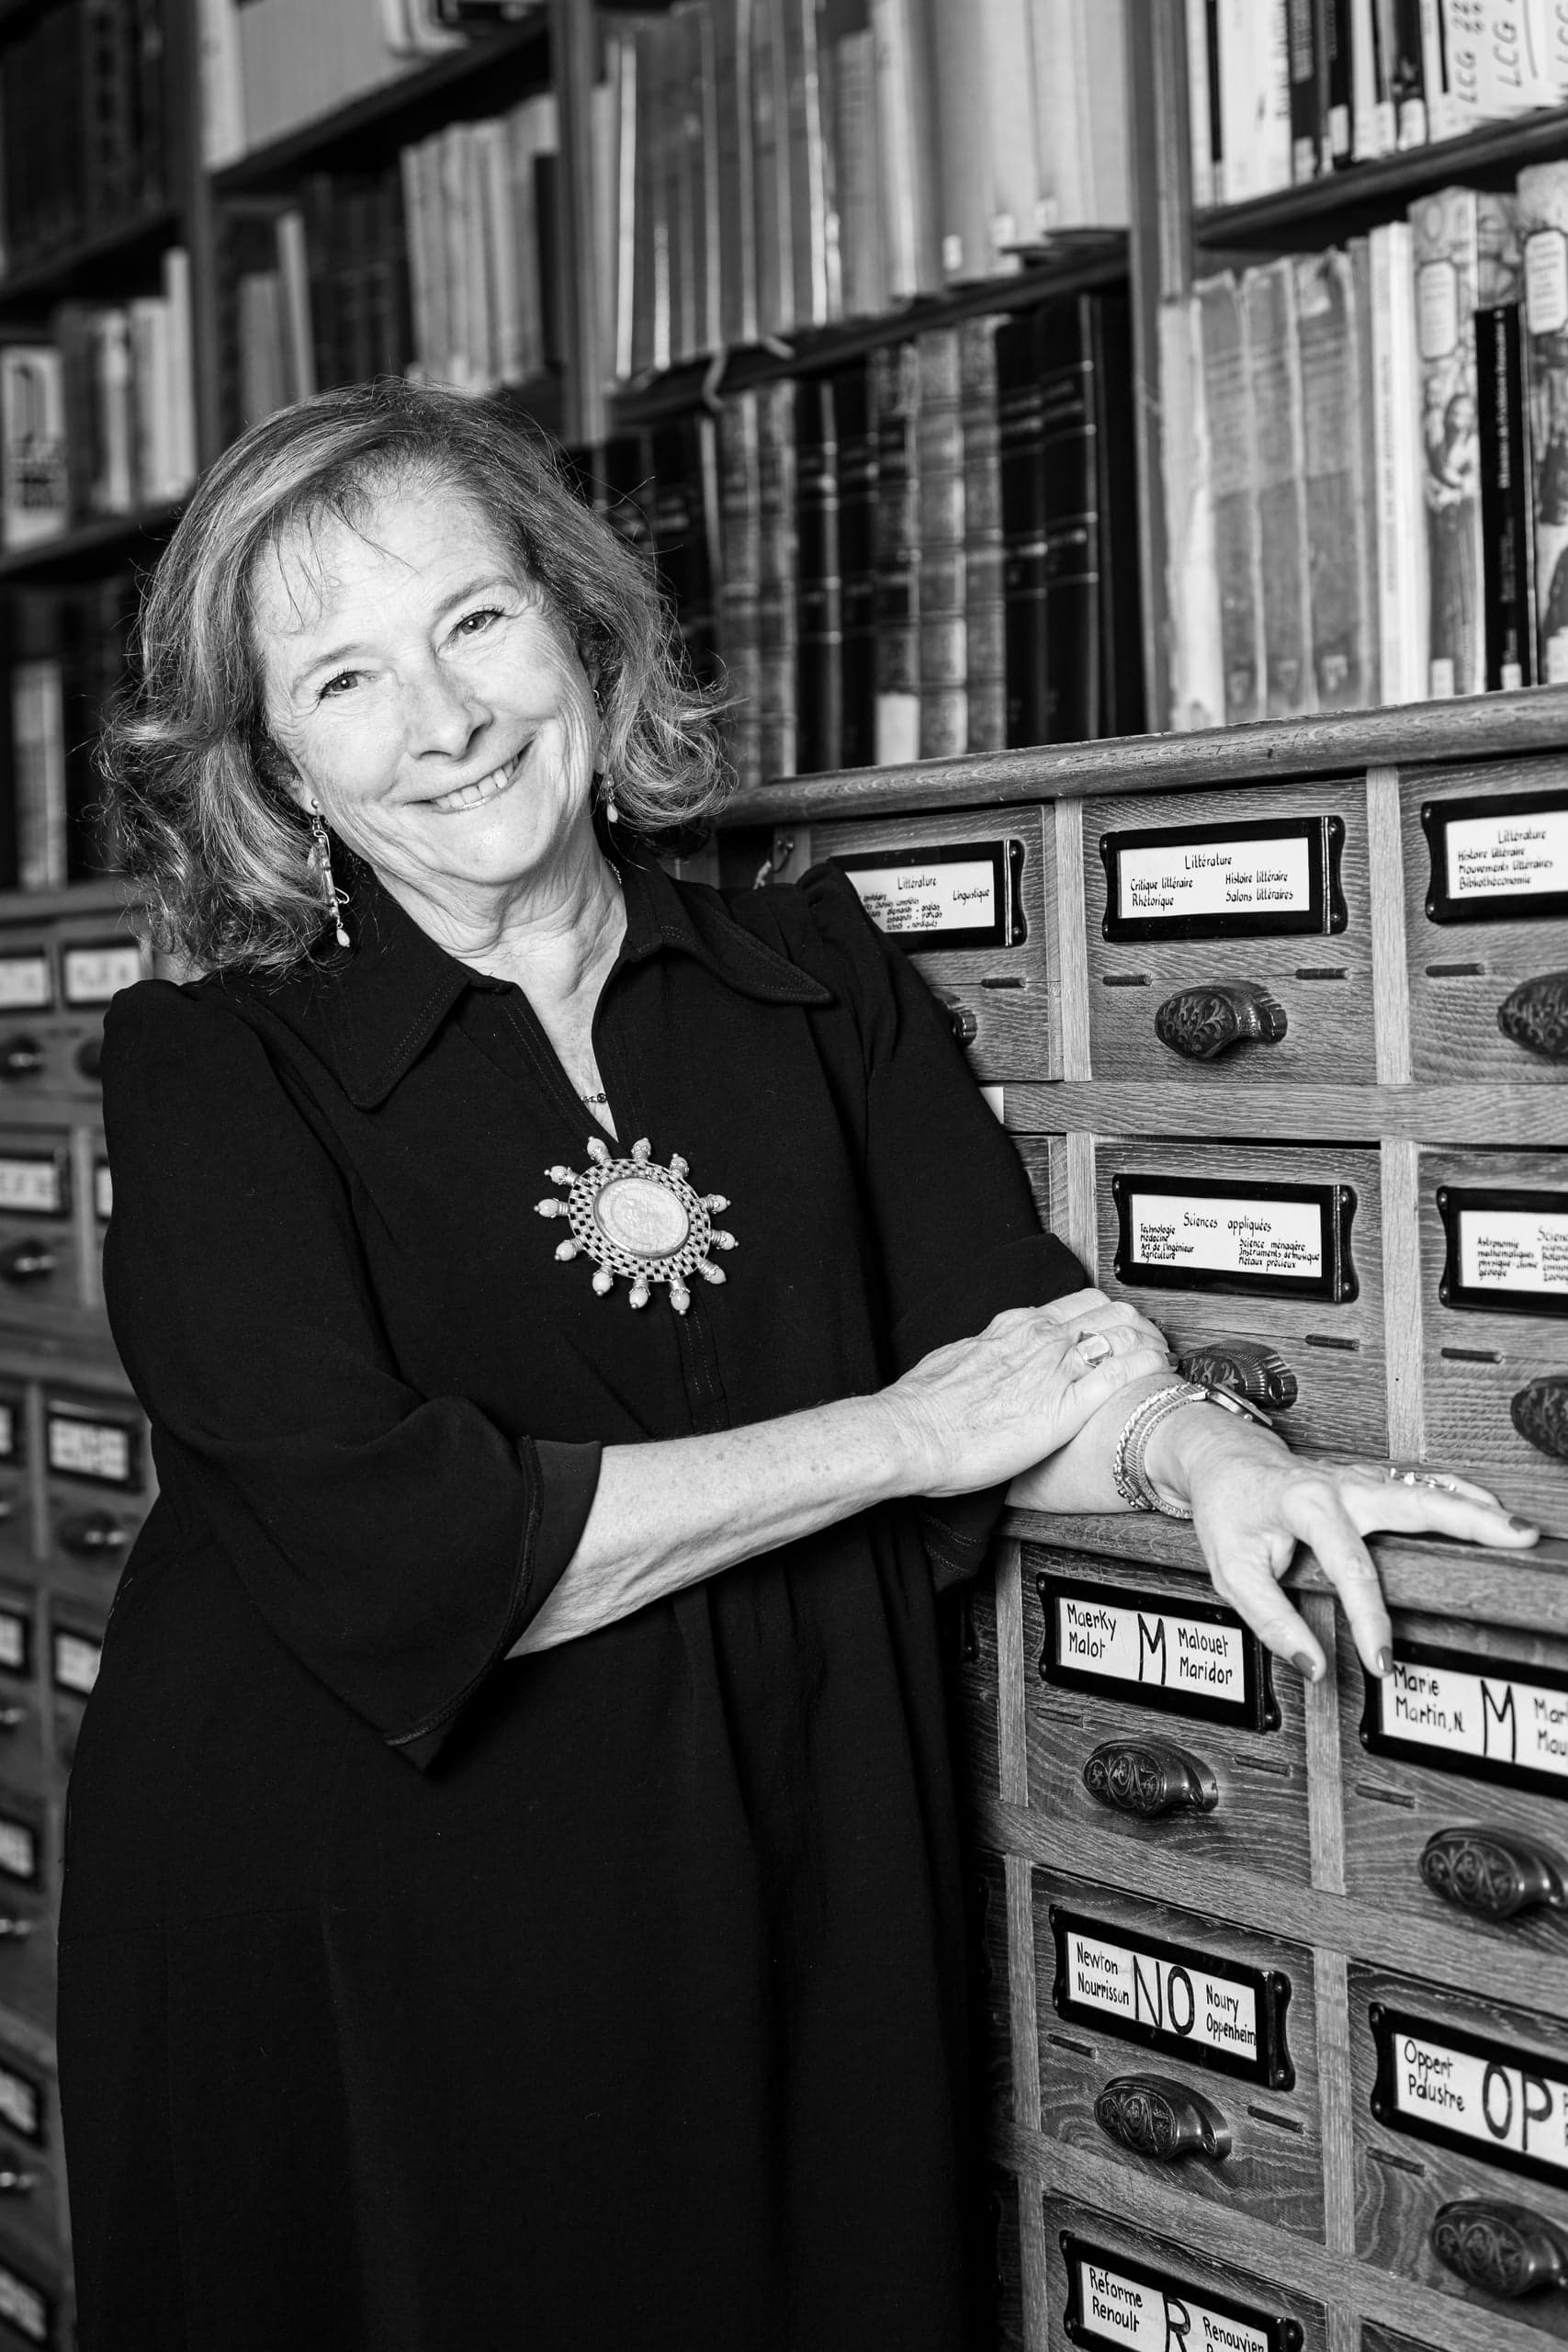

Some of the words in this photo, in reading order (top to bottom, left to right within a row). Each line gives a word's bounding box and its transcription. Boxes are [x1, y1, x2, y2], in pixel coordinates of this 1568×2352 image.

[1185, 853, 1232, 870] Littérature
[1130, 878, 1158, 894] Critique
[1162, 876, 1193, 889] littéraire
[1225, 872, 1252, 885] Histoire
[1256, 869, 1288, 883] littéraire
[953, 888, 990, 906] Linguistique
[1132, 893, 1174, 911] Rhétorique
[1225, 889, 1252, 902] Salons
[1257, 887, 1293, 901] littéraires
[1140, 1223, 1176, 1238] Technologie
[1183, 1212, 1218, 1229] Sciences
[1227, 1215, 1271, 1237] appliquées
[1141, 1242, 1150, 1250] Art
[1153, 1242, 1160, 1251] de
[1239, 1237, 1265, 1249] Science
[1141, 1250, 1176, 1263] Agriculture
[1239, 1247, 1281, 1258] Instruments
[1292, 1252, 1320, 1265] musique
[1137, 1612, 1167, 1686] M
[1178, 1627, 1228, 1657] Malouet
[1069, 1632, 1106, 1658] Malot
[1179, 1657, 1233, 1685] Maridor
[1480, 1679, 1517, 1764] M
[1534, 1697, 1568, 1724] Mar
[1077, 1941, 1118, 1975] Newton
[1133, 1954, 1195, 2037] NO
[1206, 1984, 1239, 2023] Noury
[1077, 1972, 1130, 2007] Nourrisson
[1206, 2012, 1257, 2046] Oppenheim
[1404, 2039, 1453, 2079] Oppert
[1482, 2061, 1553, 2152] OP
[1408, 2074, 1465, 2112] Palustre
[1089, 2267, 1143, 2308] Réforme
[1162, 2292, 1191, 2352] R
[1092, 2295, 1140, 2333] Renoult
